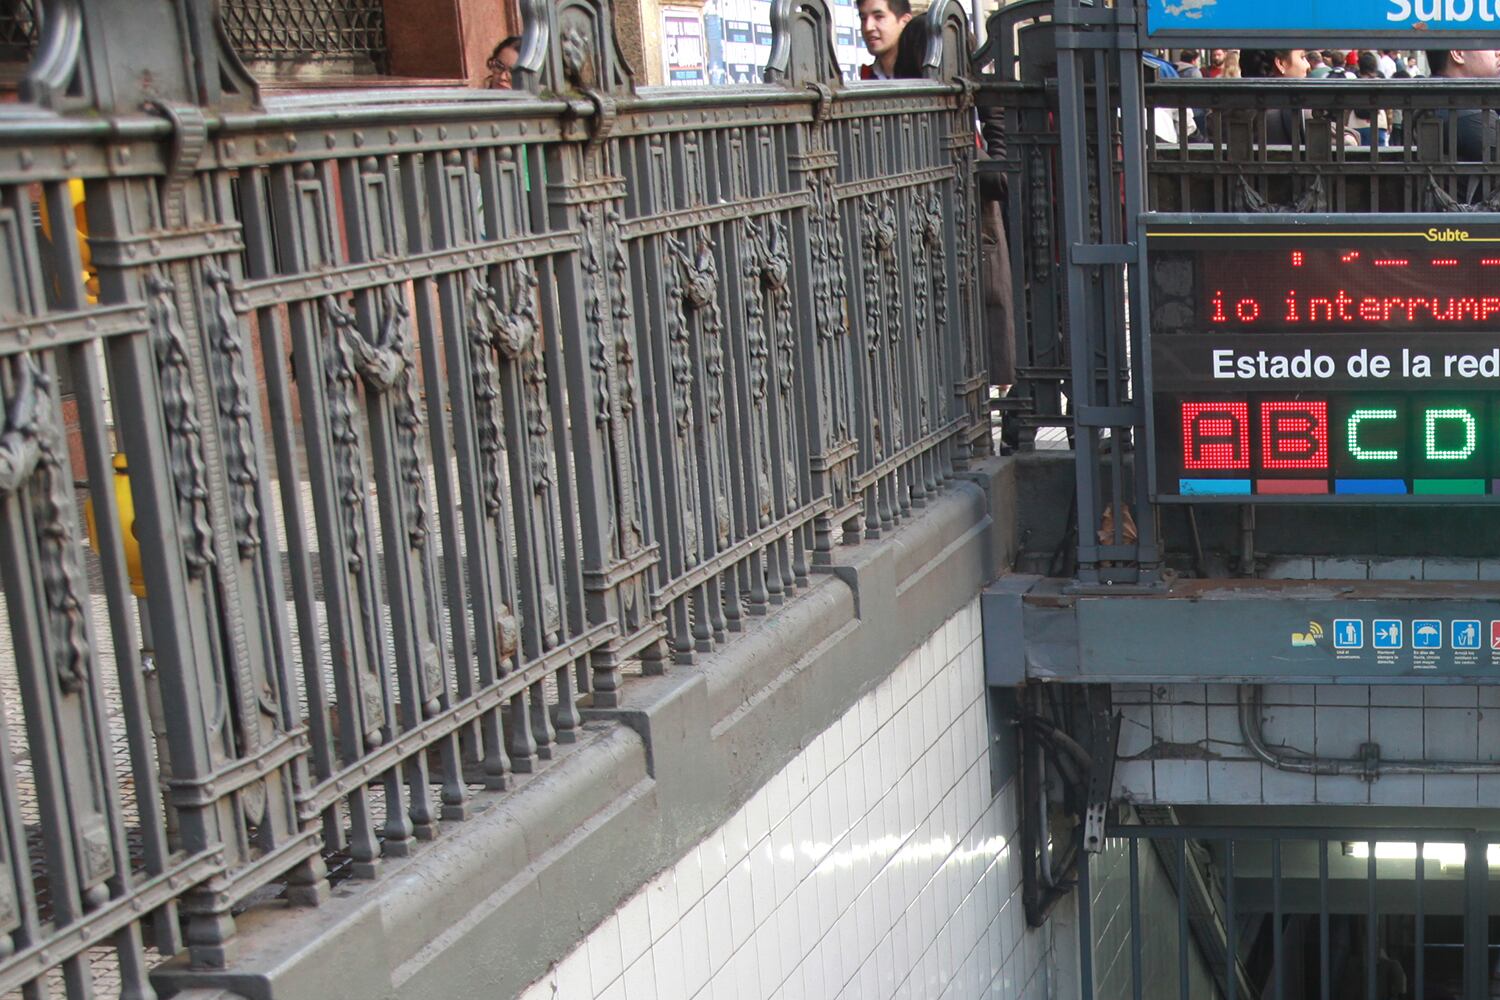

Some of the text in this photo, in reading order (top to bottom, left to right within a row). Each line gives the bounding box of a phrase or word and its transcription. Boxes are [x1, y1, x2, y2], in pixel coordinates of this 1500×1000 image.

[1427, 228, 1469, 242] Subte
[1212, 349, 1335, 379] Estado
[1346, 349, 1391, 378] de
[1402, 349, 1432, 378] la
[1444, 349, 1500, 378] red
[1347, 409, 1398, 460] C
[1425, 409, 1476, 460] D
